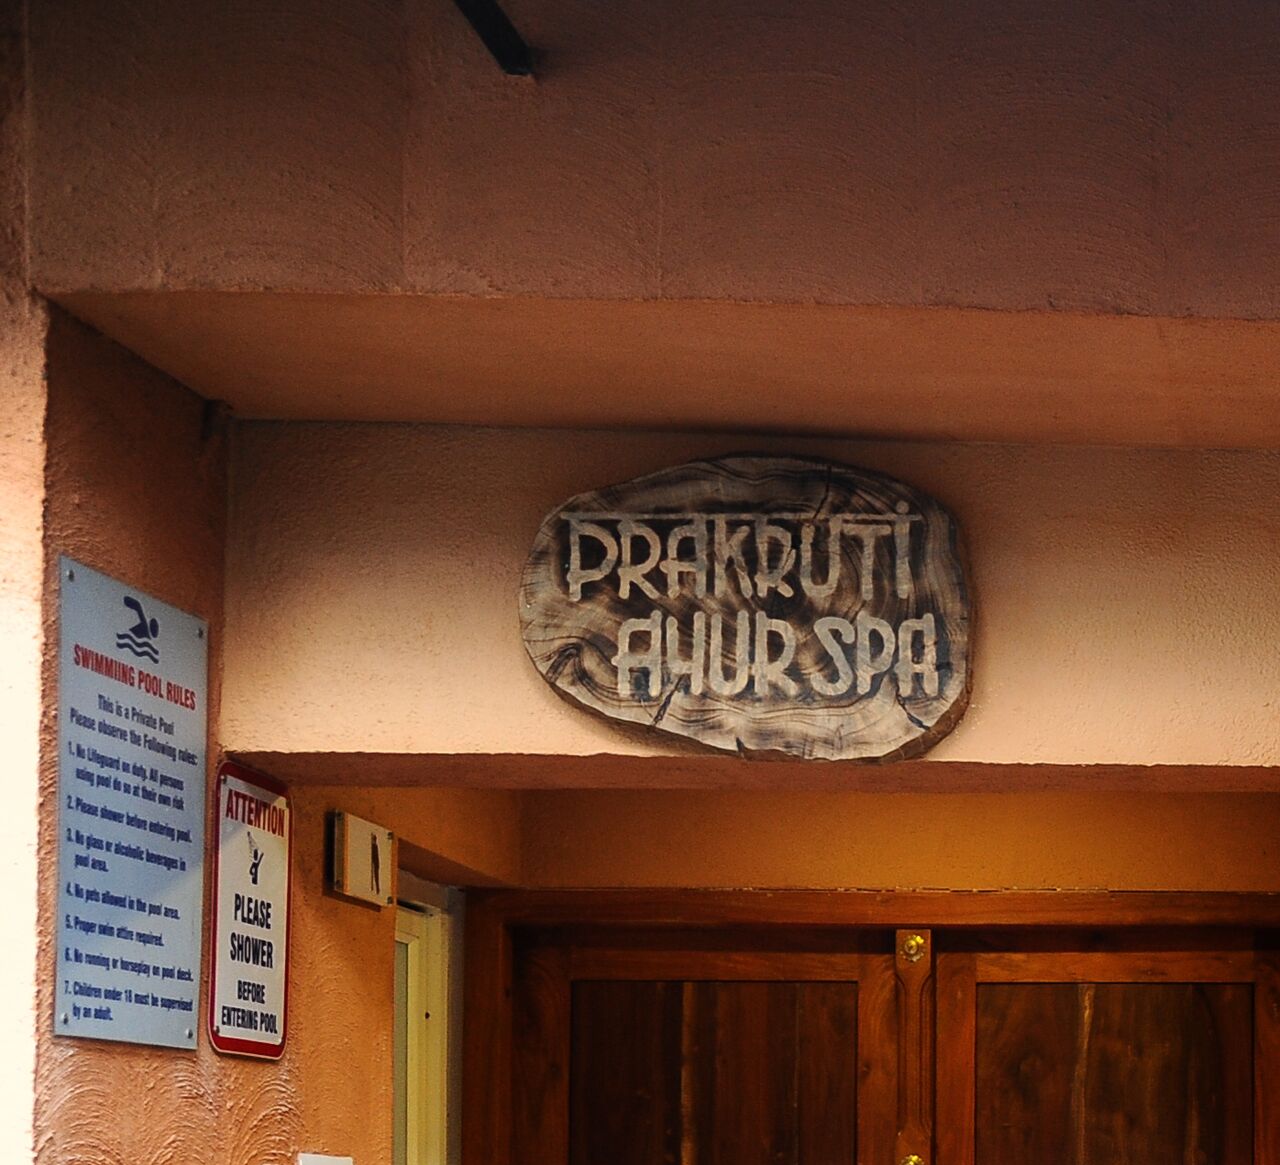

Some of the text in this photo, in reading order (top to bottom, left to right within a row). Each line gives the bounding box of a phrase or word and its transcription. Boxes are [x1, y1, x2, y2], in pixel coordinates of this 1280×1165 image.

[560, 502, 922, 600] PRAKRUTI
[811, 610, 940, 698] SPA
[138, 670, 164, 699] POOL
[166, 681, 196, 711] RULES
[70, 706, 96, 731] Please
[98, 718, 128, 742] observe
[129, 729, 142, 747] the
[98, 693, 175, 736] This is a Private Pool
[68, 740, 75, 756] 1.
[75, 796, 99, 817] Please
[225, 788, 286, 837] ATTENTION
[234, 893, 272, 930] PLEASE
[230, 932, 274, 969] SHOWER
[64, 980, 72, 995] 7.
[237, 979, 266, 1005] BEFORE
[221, 1005, 278, 1034] ENTERING POOL
